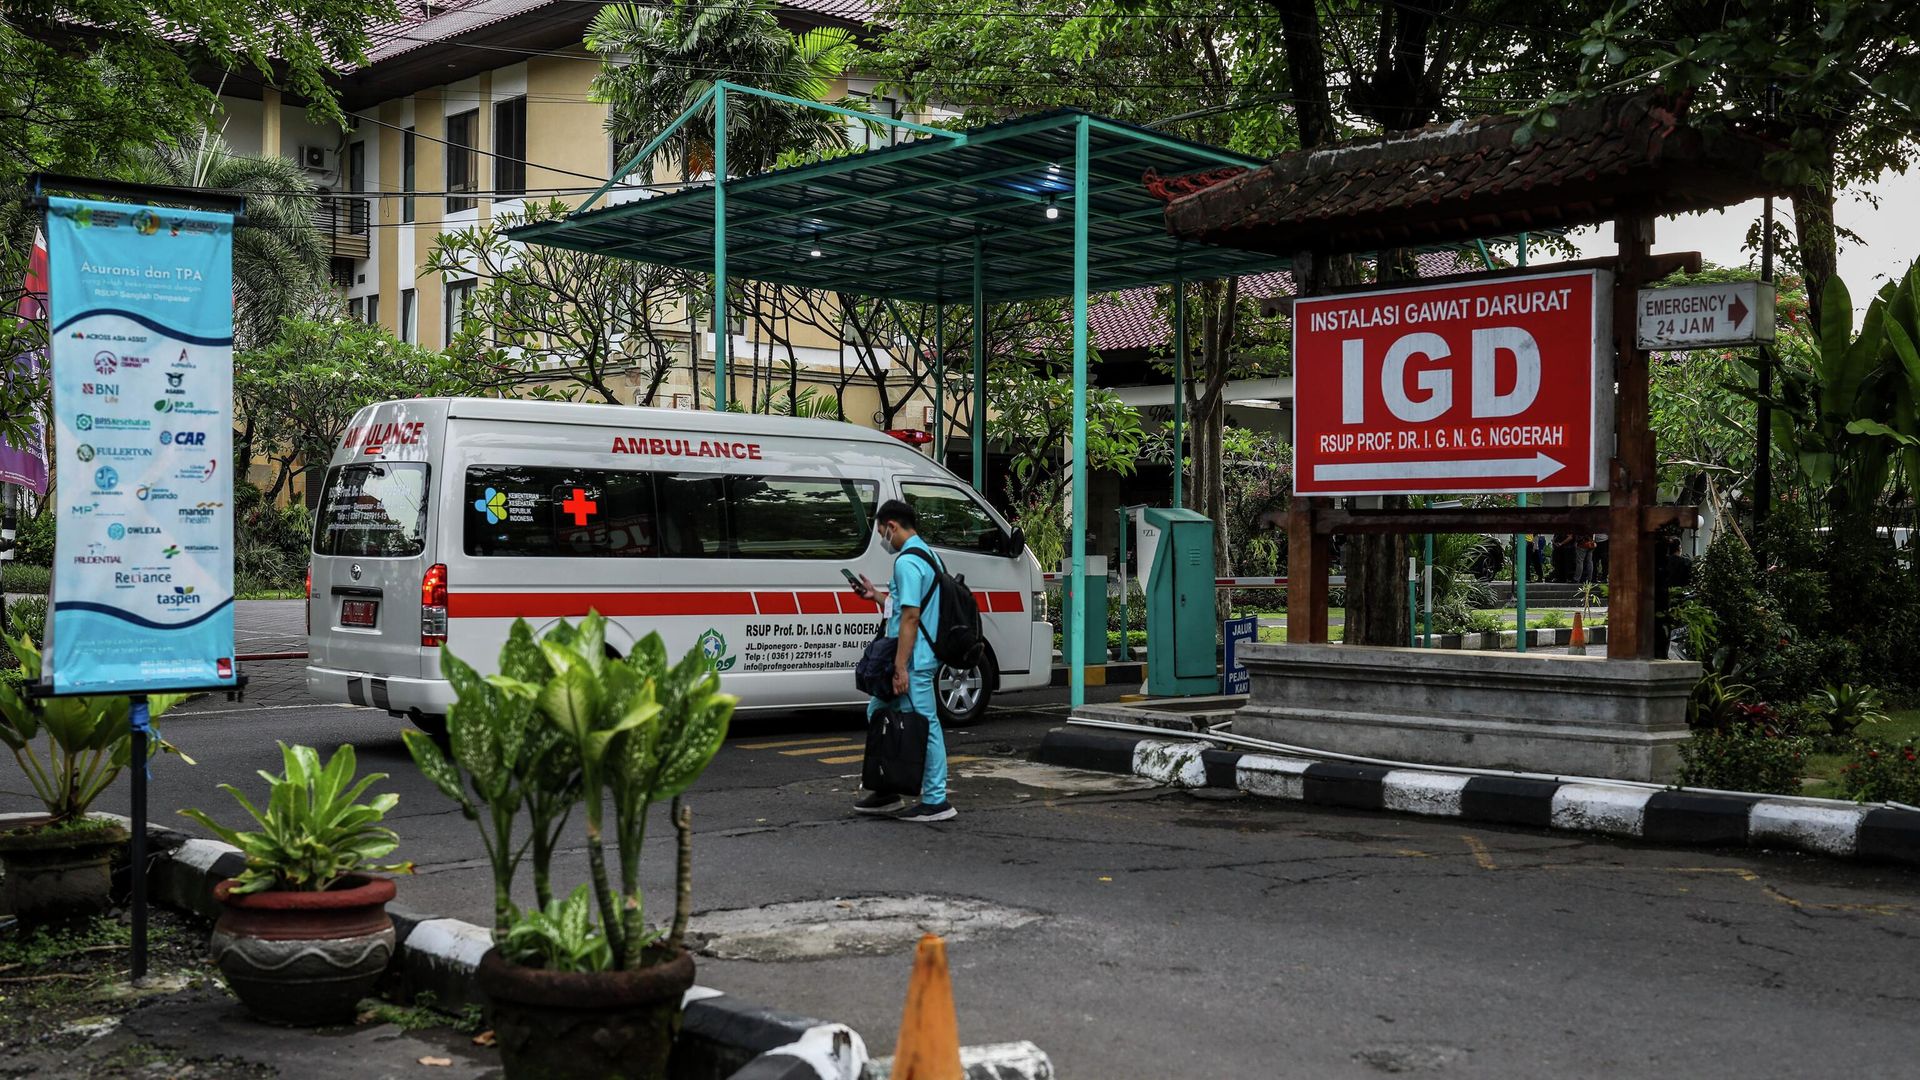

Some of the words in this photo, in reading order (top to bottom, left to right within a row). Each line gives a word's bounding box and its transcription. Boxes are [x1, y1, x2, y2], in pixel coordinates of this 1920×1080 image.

[81, 261, 140, 277] Asuransi
[145, 265, 170, 279] dan
[176, 268, 202, 281] TPA
[95, 288, 119, 297] RSUP
[1311, 306, 1399, 332] INSTALASI
[1405, 298, 1471, 324] GAWAT
[1476, 288, 1571, 318] DARURAT
[1646, 294, 1727, 316] EMERGENCY
[1657, 319, 1675, 336] 24
[1680, 317, 1714, 334] JAM
[86, 333, 111, 341] ACROSS
[1342, 326, 1542, 424] IGD
[95, 384, 119, 395] BNI
[175, 431, 206, 446] CAR
[1320, 433, 1354, 453] RSUP
[1357, 431, 1394, 451] PROF.
[1398, 430, 1421, 449] DR.
[1424, 430, 1432, 449] I.
[1435, 429, 1449, 448] G.
[1453, 428, 1467, 448] N.
[1471, 428, 1486, 447] G.
[1489, 426, 1563, 447] NGOERAH
[96, 447, 152, 456] FULLERTON
[612, 437, 762, 460] AMBULANCE
[151, 492, 178, 501] jasindo
[74, 556, 122, 564] PRUDENTIAL
[115, 572, 172, 584] Reliance
[157, 594, 200, 607] taspen
[746, 624, 771, 637] RSUP
[773, 624, 794, 637] Prof.
[797, 624, 809, 636] Dr.
[811, 623, 832, 636] I.G.N
[835, 623, 842, 635] G
[844, 623, 881, 635] NGOERA
[1232, 623, 1252, 636] JALUR
[746, 642, 797, 652] JL.Diponegoro
[804, 641, 836, 651] Denpasar
[842, 641, 859, 649] BALI
[745, 653, 761, 661] Telp
[772, 652, 789, 660] 0361
[796, 651, 832, 660] 227911-15
[744, 660, 859, 672] info@profngoerahhospitalbali.co
[1229, 671, 1249, 682] PEJALA
